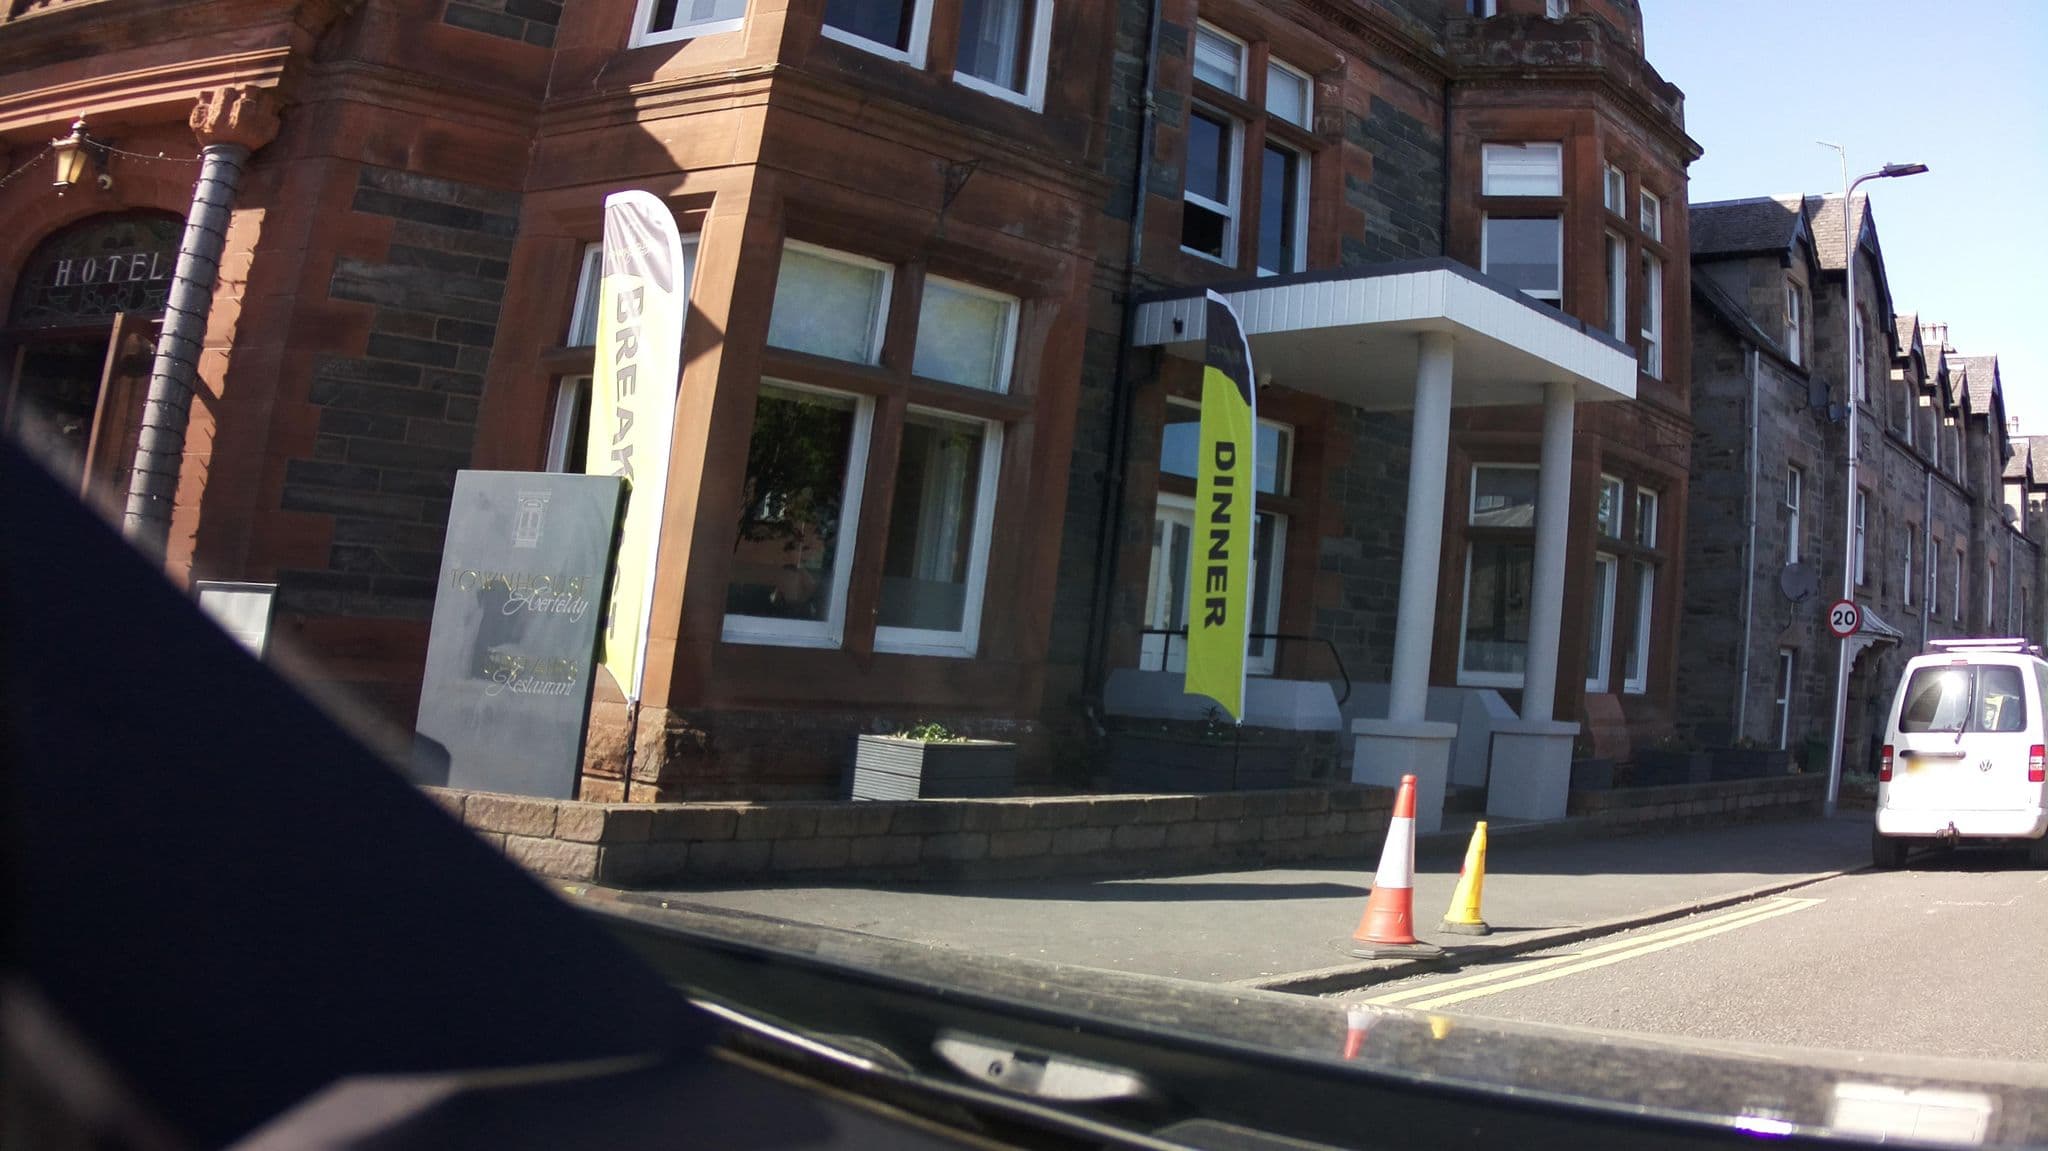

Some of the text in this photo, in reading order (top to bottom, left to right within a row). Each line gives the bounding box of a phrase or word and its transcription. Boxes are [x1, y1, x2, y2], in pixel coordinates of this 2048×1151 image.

[55, 252, 164, 286] HOTEL
[1204, 441, 1236, 629] DINNER
[502, 585, 589, 623] Aberfeldy
[1832, 611, 1856, 626] 20
[485, 666, 577, 696] Restaurant
